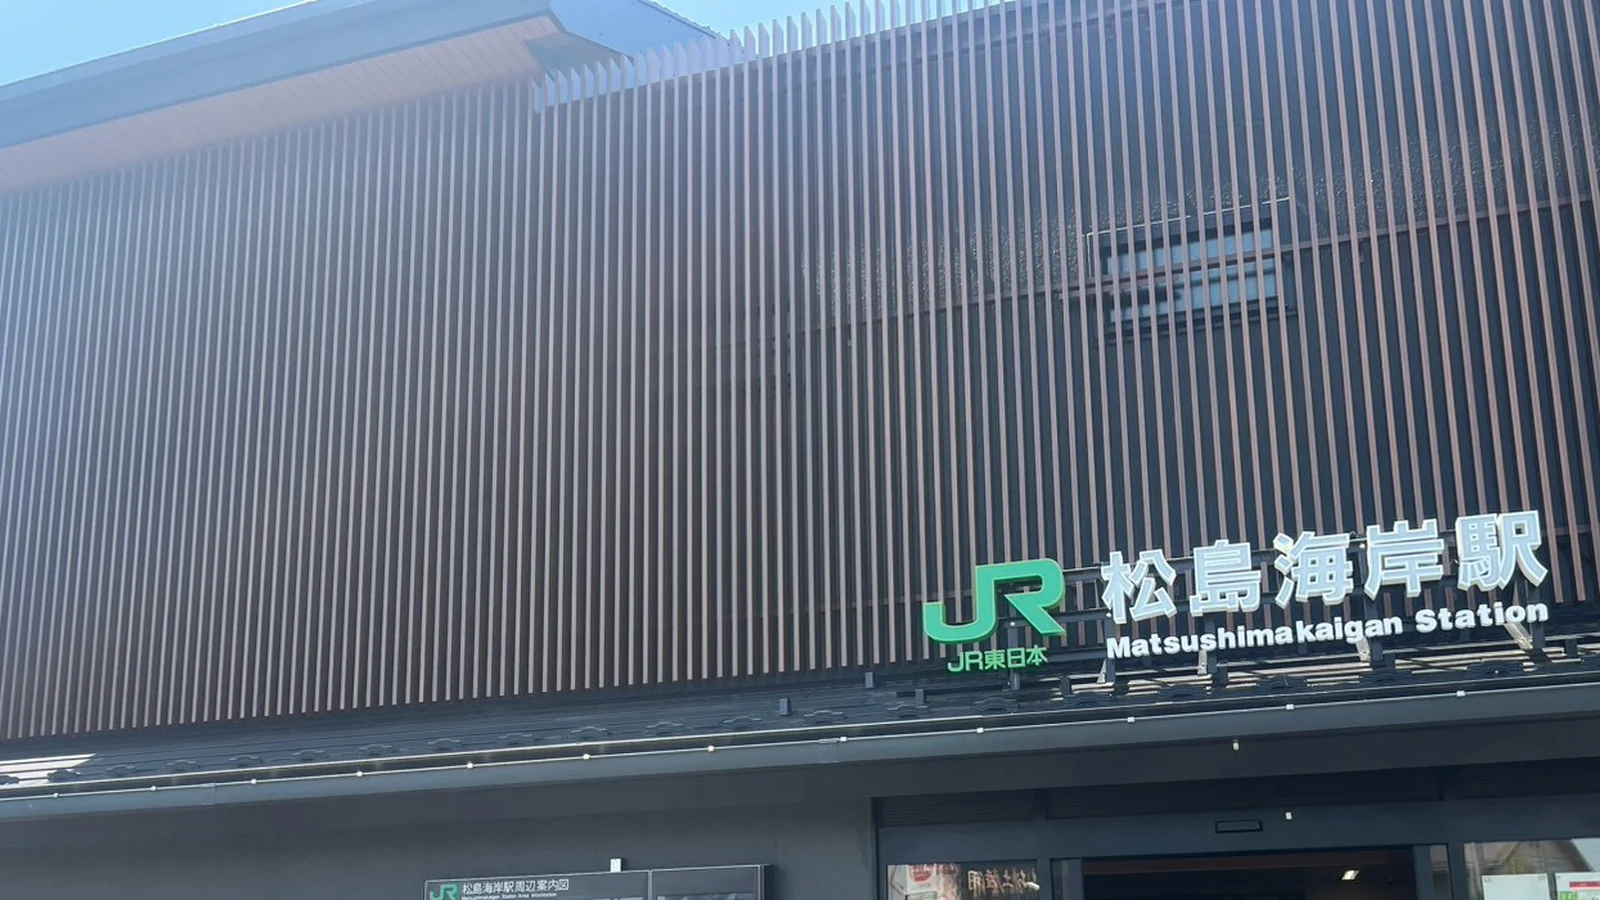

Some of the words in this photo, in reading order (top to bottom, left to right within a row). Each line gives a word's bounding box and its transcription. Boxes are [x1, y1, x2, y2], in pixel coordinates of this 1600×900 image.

[1101, 510, 1548, 624] 松島海岸駅
[923, 558, 1065, 643] JR
[1106, 616, 1403, 658] Matsushimakaigan
[1415, 601, 1549, 633] Station
[948, 645, 1048, 672] JR東日本
[430, 884, 457, 900] JR
[462, 879, 569, 895] 松島海岸駅周辺案内図
